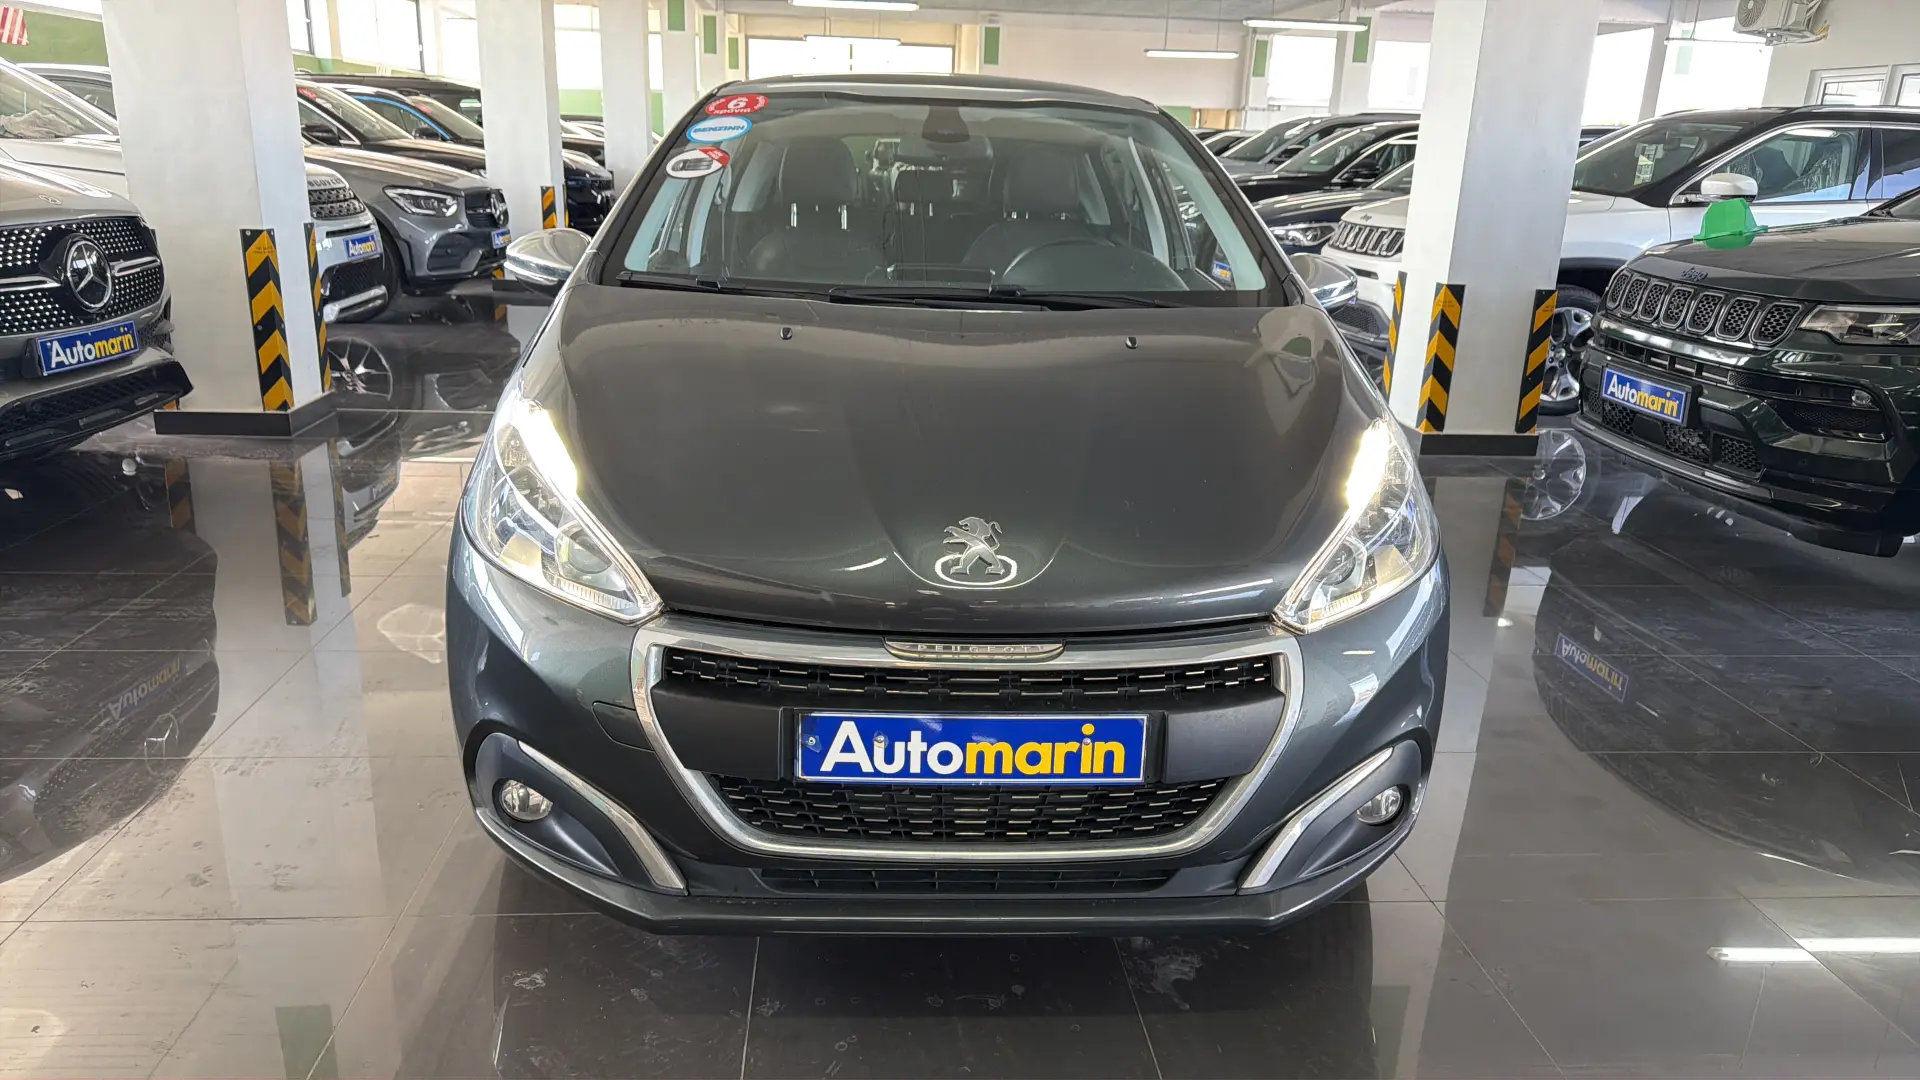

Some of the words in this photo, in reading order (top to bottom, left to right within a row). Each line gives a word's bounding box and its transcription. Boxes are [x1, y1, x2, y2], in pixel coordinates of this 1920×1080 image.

[728, 96, 748, 109] 6
[1681, 267, 1708, 281] Jeep
[51, 327, 135, 368] Automarin
[1607, 374, 1678, 417] Automarin
[820, 721, 1125, 775] Automarin
